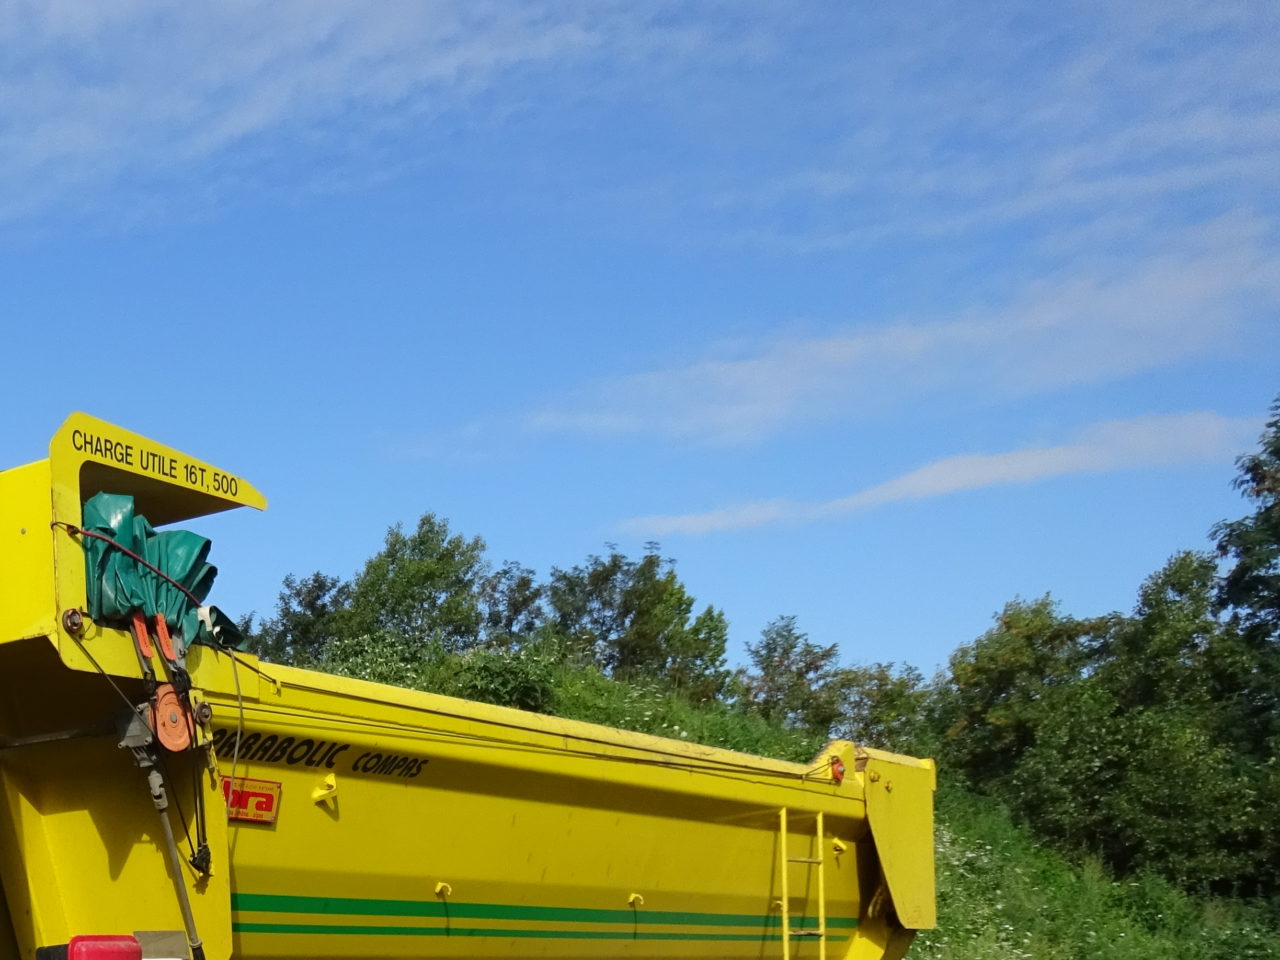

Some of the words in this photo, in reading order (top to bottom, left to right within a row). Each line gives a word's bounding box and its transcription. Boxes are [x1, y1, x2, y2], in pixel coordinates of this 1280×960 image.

[72, 430, 133, 466] CHARGE
[140, 449, 177, 479] UTILE
[352, 752, 429, 778] COMPAS
